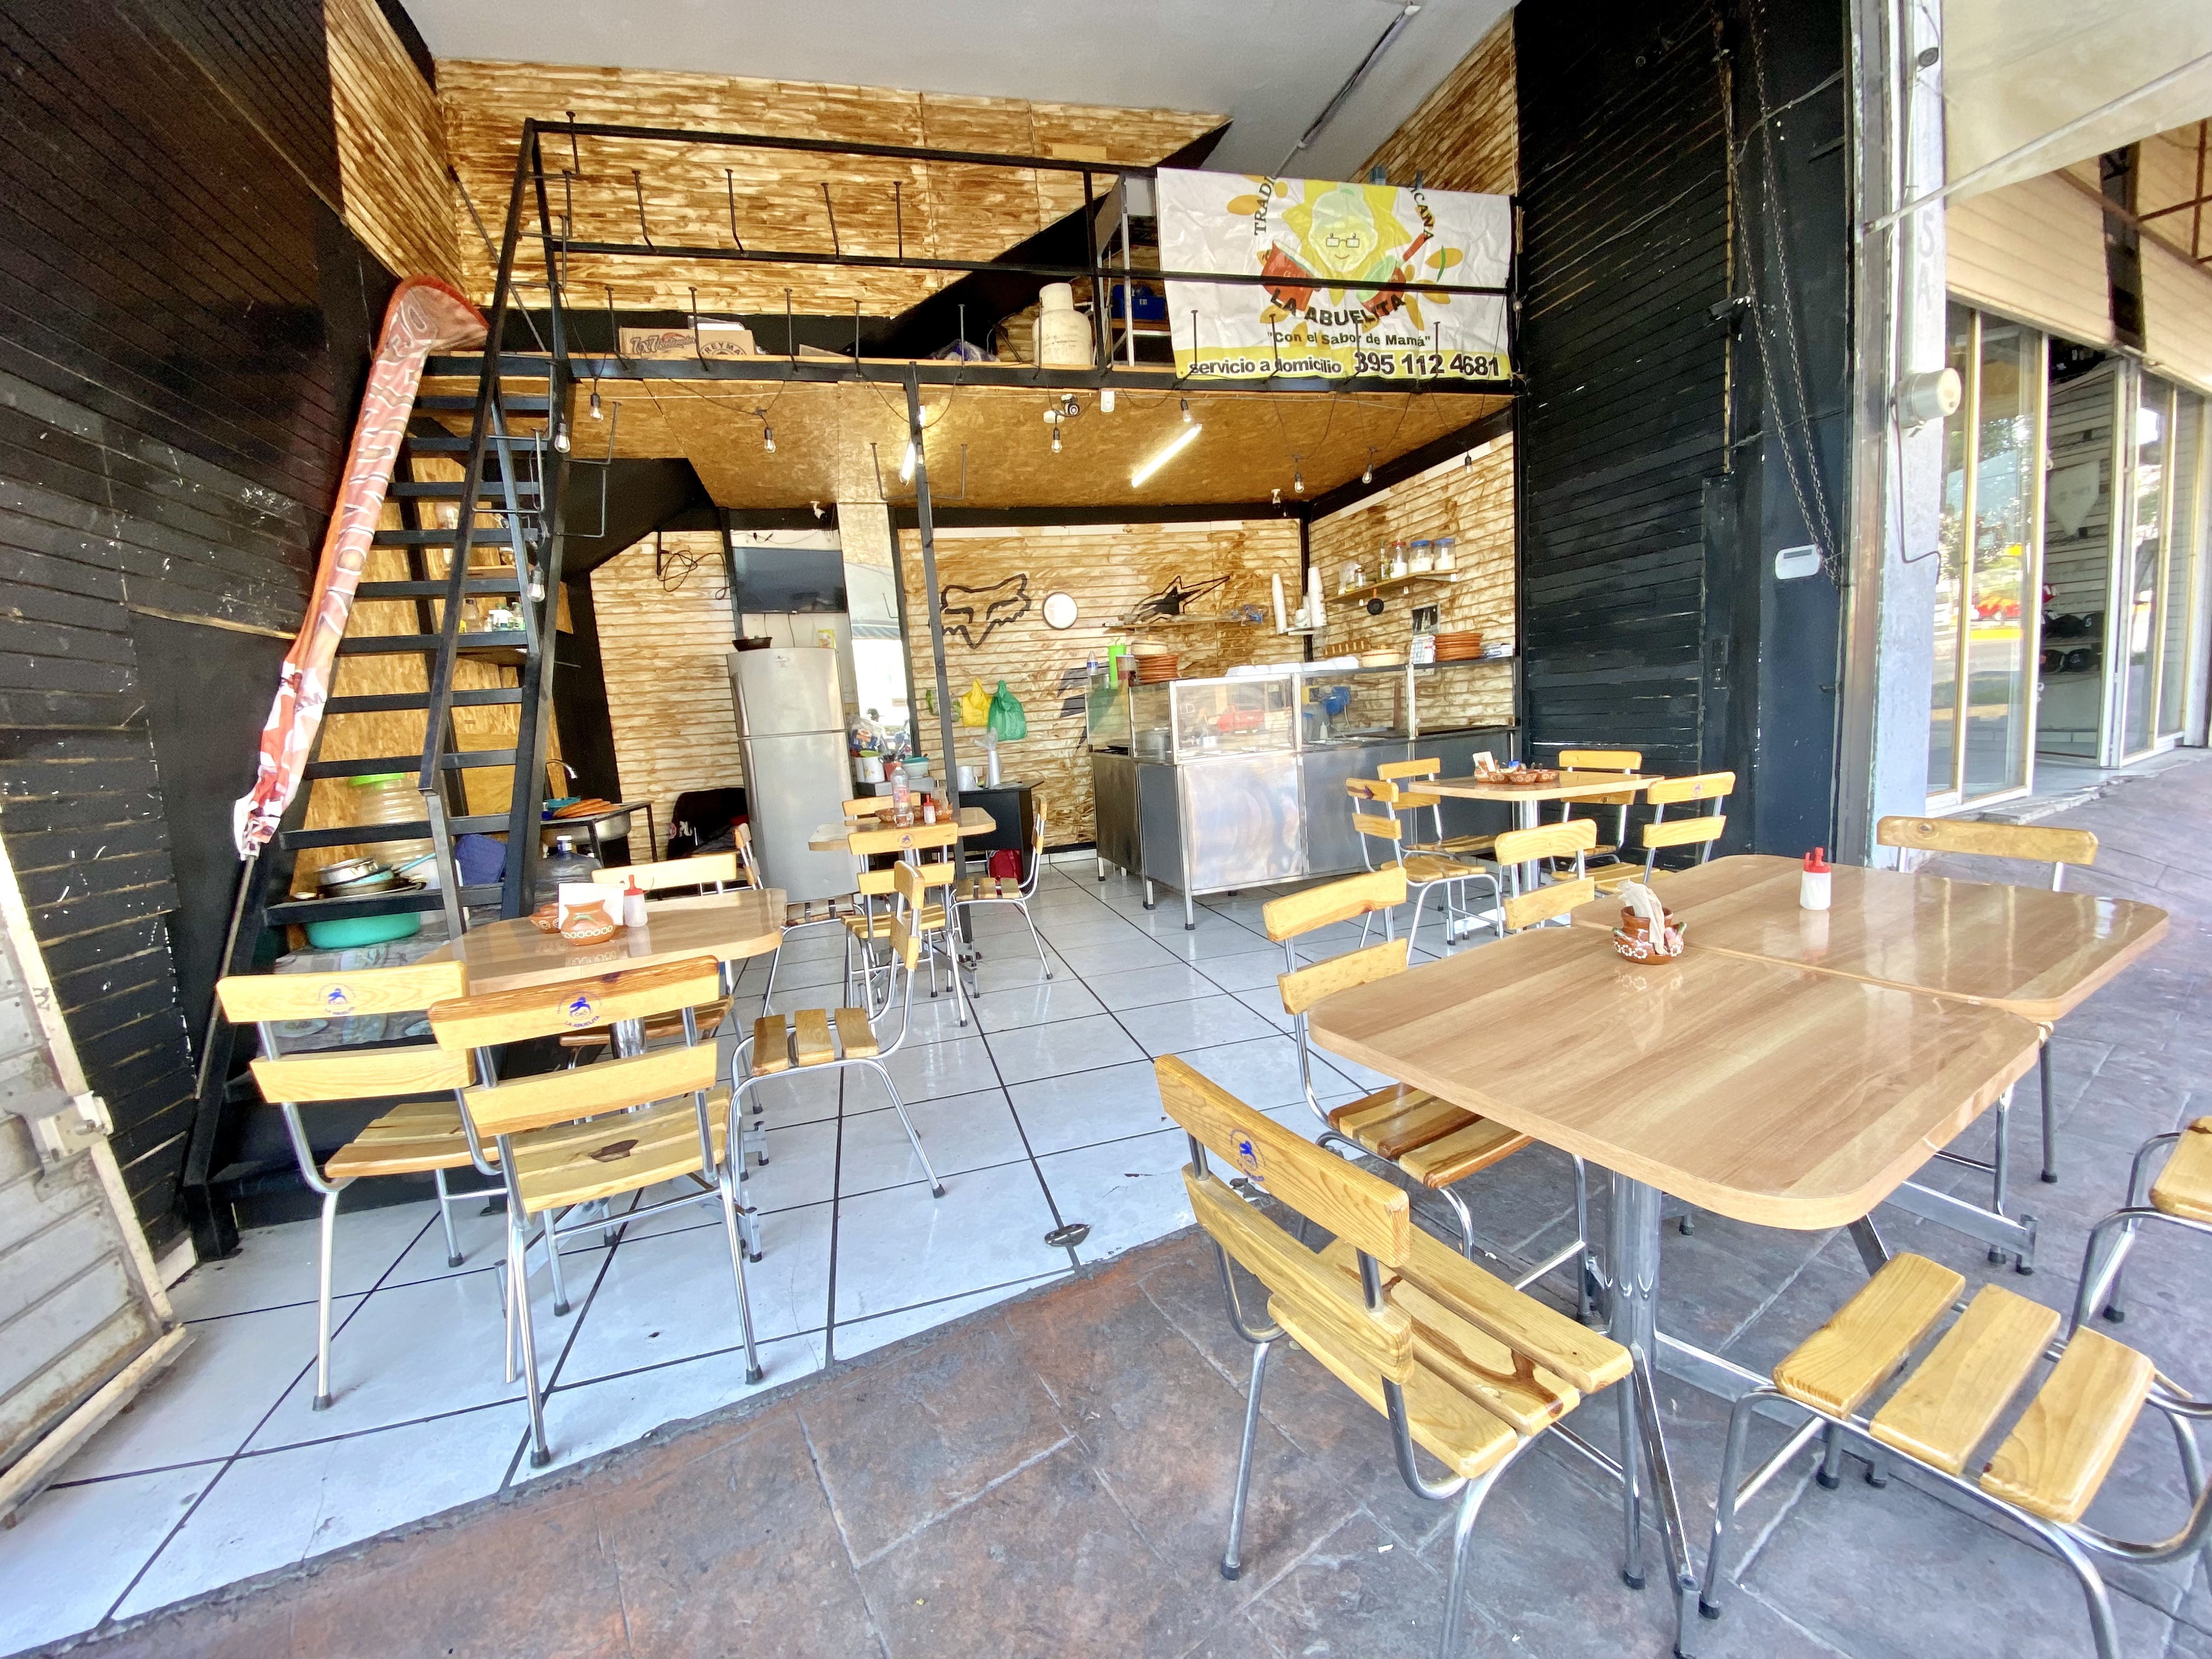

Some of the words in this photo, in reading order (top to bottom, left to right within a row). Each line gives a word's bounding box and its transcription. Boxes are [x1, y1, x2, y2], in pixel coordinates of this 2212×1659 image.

[1254, 176, 1277, 236] TRADI
[1270, 287, 1296, 317] LA
[1304, 294, 1406, 326] ABUELITA
[1307, 331, 1317, 342] el
[1365, 333, 1380, 345] de
[1189, 358, 1256, 374] servicio
[1260, 363, 1270, 372] a
[1275, 357, 1342, 374] domicilio
[1354, 352, 1395, 375] 395
[1401, 353, 1445, 375] 112
[1449, 353, 1499, 376] 4681
